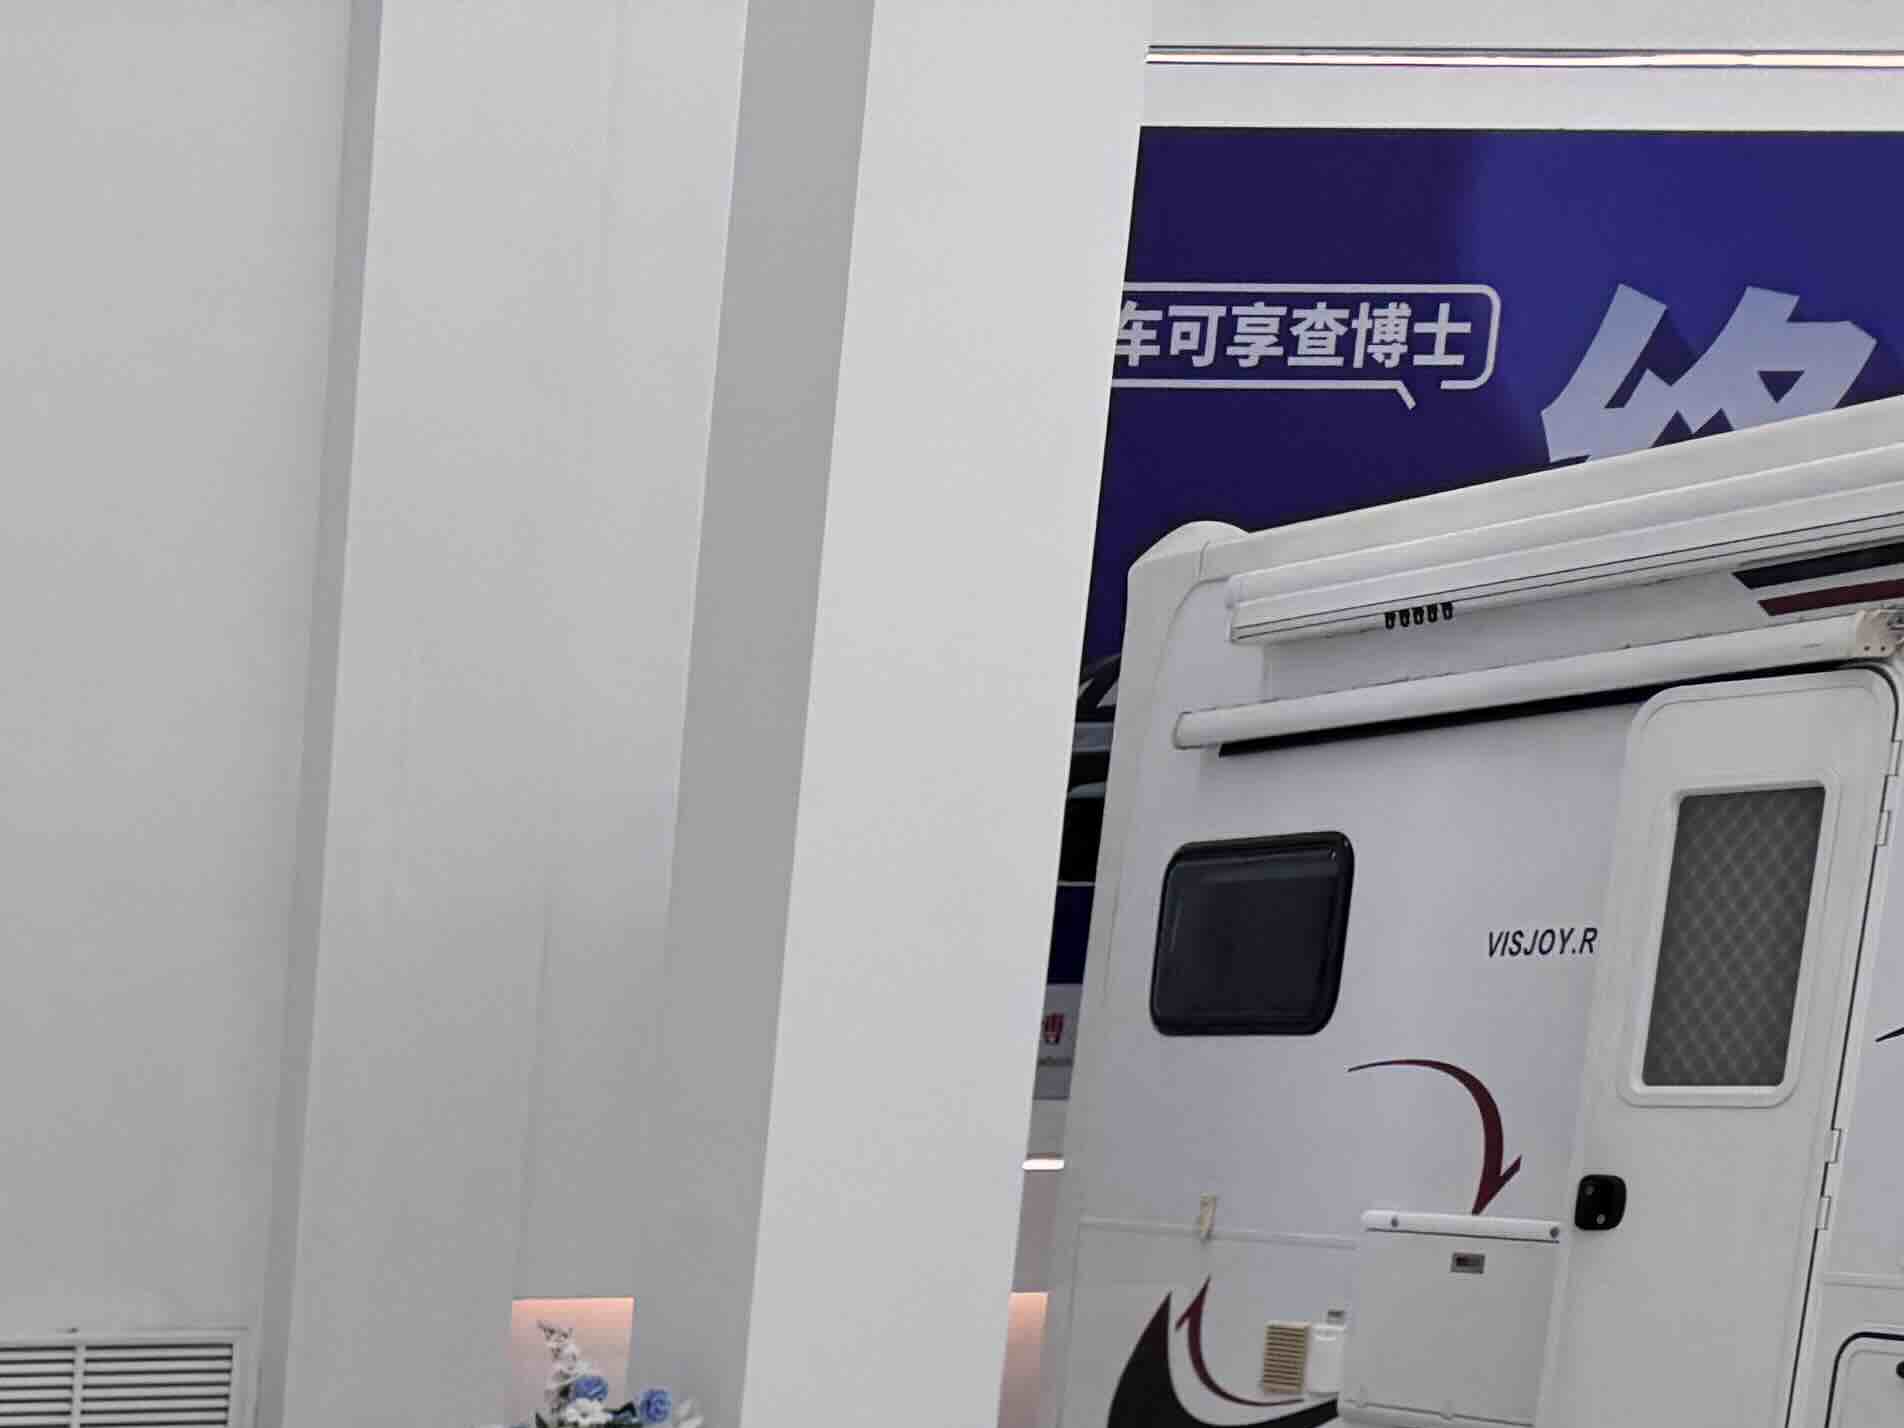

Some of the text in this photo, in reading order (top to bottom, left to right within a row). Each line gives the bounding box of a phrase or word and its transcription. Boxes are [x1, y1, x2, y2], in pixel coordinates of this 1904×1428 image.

[1115, 300, 1472, 369] 车可享查博士
